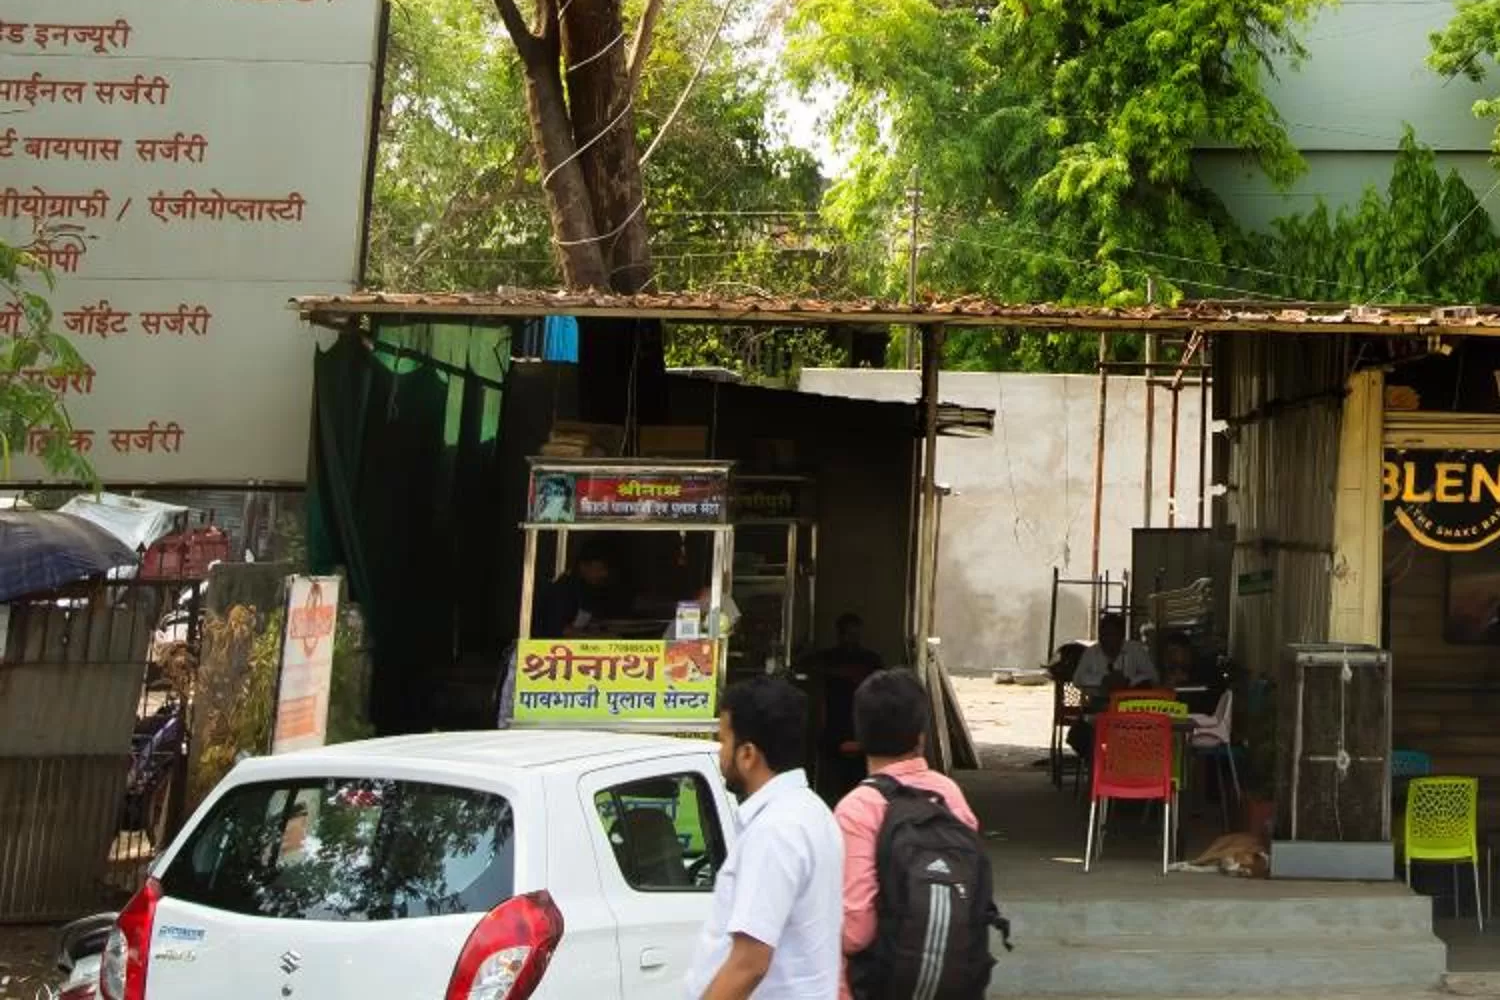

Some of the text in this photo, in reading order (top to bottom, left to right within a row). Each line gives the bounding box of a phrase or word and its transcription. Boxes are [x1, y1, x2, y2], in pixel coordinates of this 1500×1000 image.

[94, 75, 170, 105] सर्जरी
[24, 137, 122, 162] बायपास
[136, 132, 209, 163] सर्जरी
[140, 304, 212, 335] सर्जरी
[108, 420, 184, 453] सर्जरी
[1436, 526, 1479, 538] SHAKE
[522, 644, 660, 682] श्रीनाथ
[519, 684, 710, 715] पावभाजी पुलाव सेन्टर
